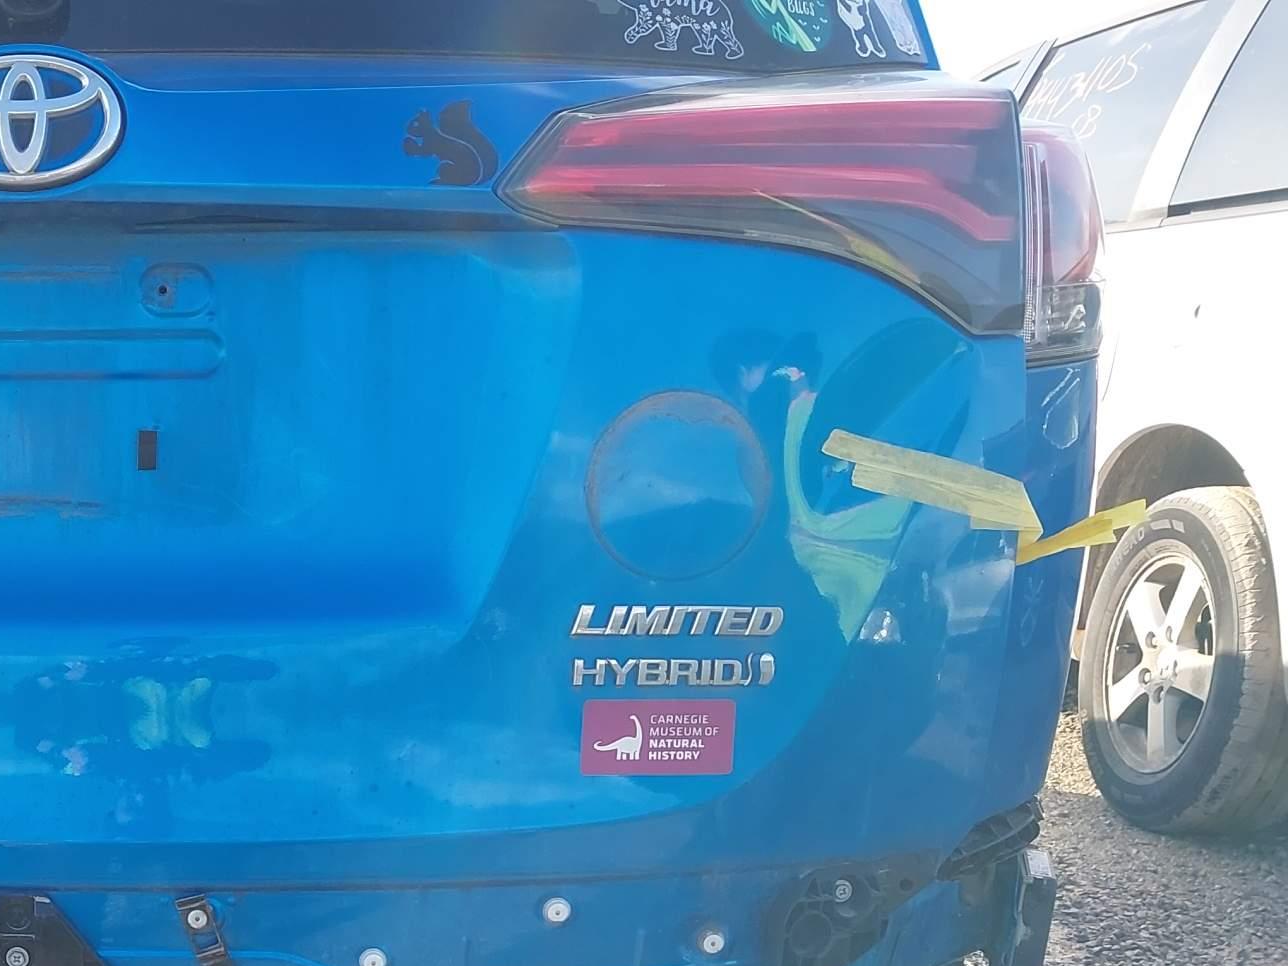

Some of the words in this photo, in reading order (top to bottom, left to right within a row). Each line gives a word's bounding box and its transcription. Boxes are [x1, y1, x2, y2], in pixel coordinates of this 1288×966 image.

[570, 604, 784, 636] LIMITED
[572, 658, 744, 687] HYBRID
[650, 714, 709, 725] CARNEGIE
[649, 727, 702, 737] MUSEUM
[704, 727, 720, 737] OF
[649, 739, 705, 749] NATURAL
[648, 751, 701, 761] HISTORY
